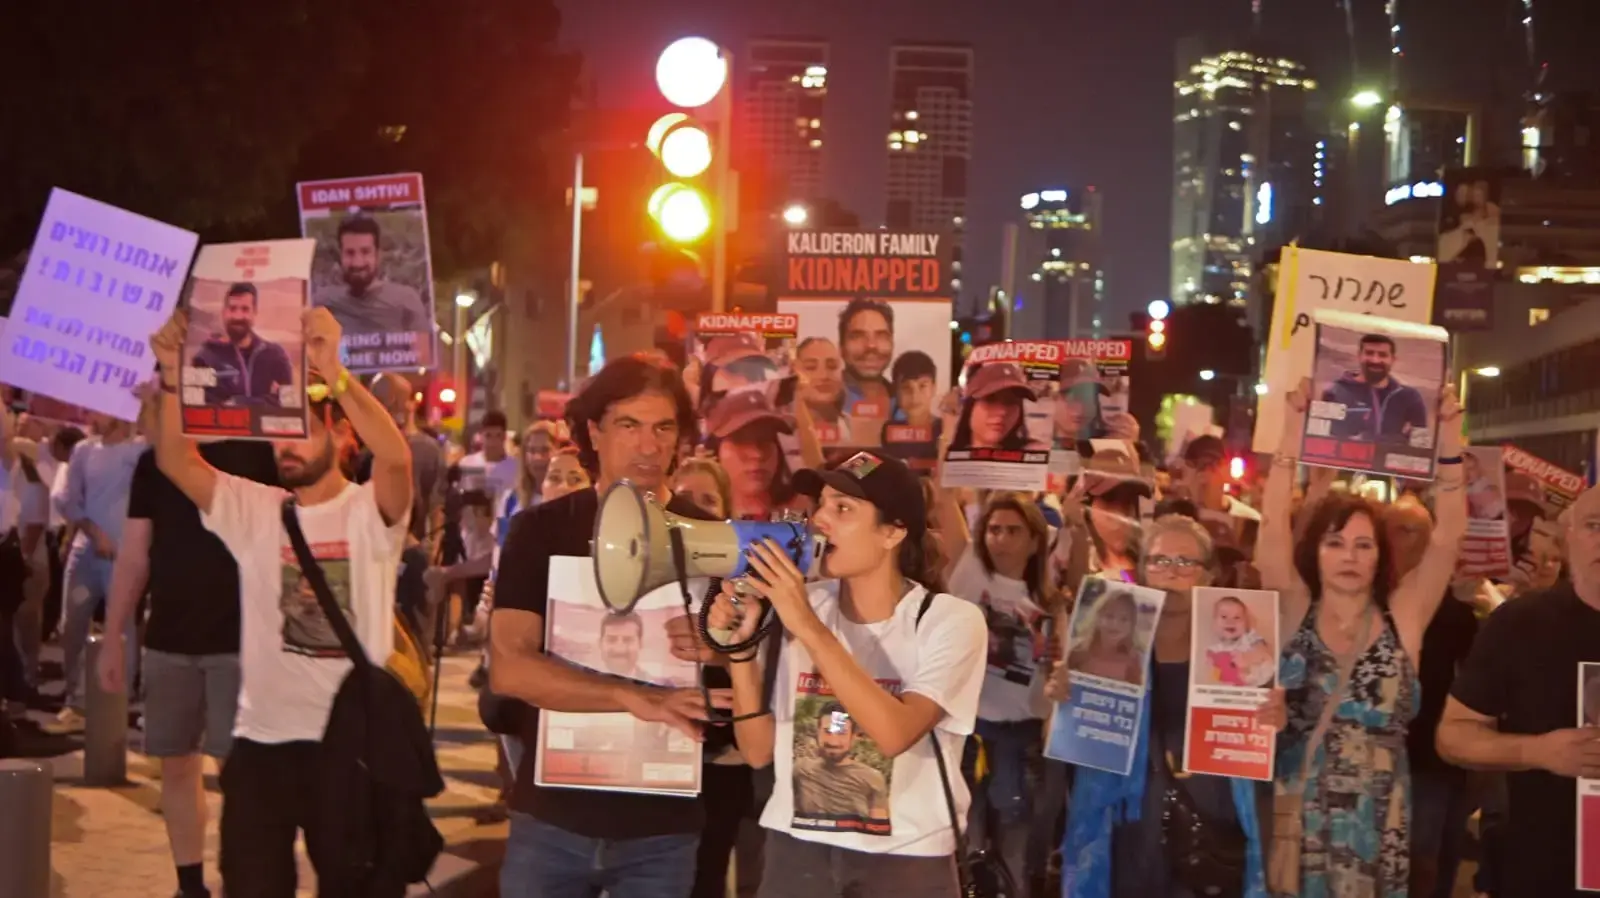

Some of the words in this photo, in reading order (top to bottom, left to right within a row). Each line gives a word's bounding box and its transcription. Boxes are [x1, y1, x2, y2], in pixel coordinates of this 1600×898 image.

[311, 188, 350, 204] IDAN
[353, 183, 410, 201] SHTIVI
[50, 220, 110, 256] רוצים
[788, 232, 876, 254] KALDERON
[880, 233, 939, 256] FAMILY
[113, 242, 178, 279] אנחנו
[788, 257, 940, 292] KIDNAPPED
[1308, 274, 1407, 308] שחרור
[700, 315, 796, 329] KIDNAPPED
[86, 326, 146, 359] תחזירו
[341, 331, 381, 346] RING
[970, 341, 1059, 362] KIDNAPPED
[12, 334, 87, 375] הביתה
[341, 351, 375, 366] OME
[88, 359, 138, 388] עידן
[1501, 448, 1581, 492] KIDNAPPED
